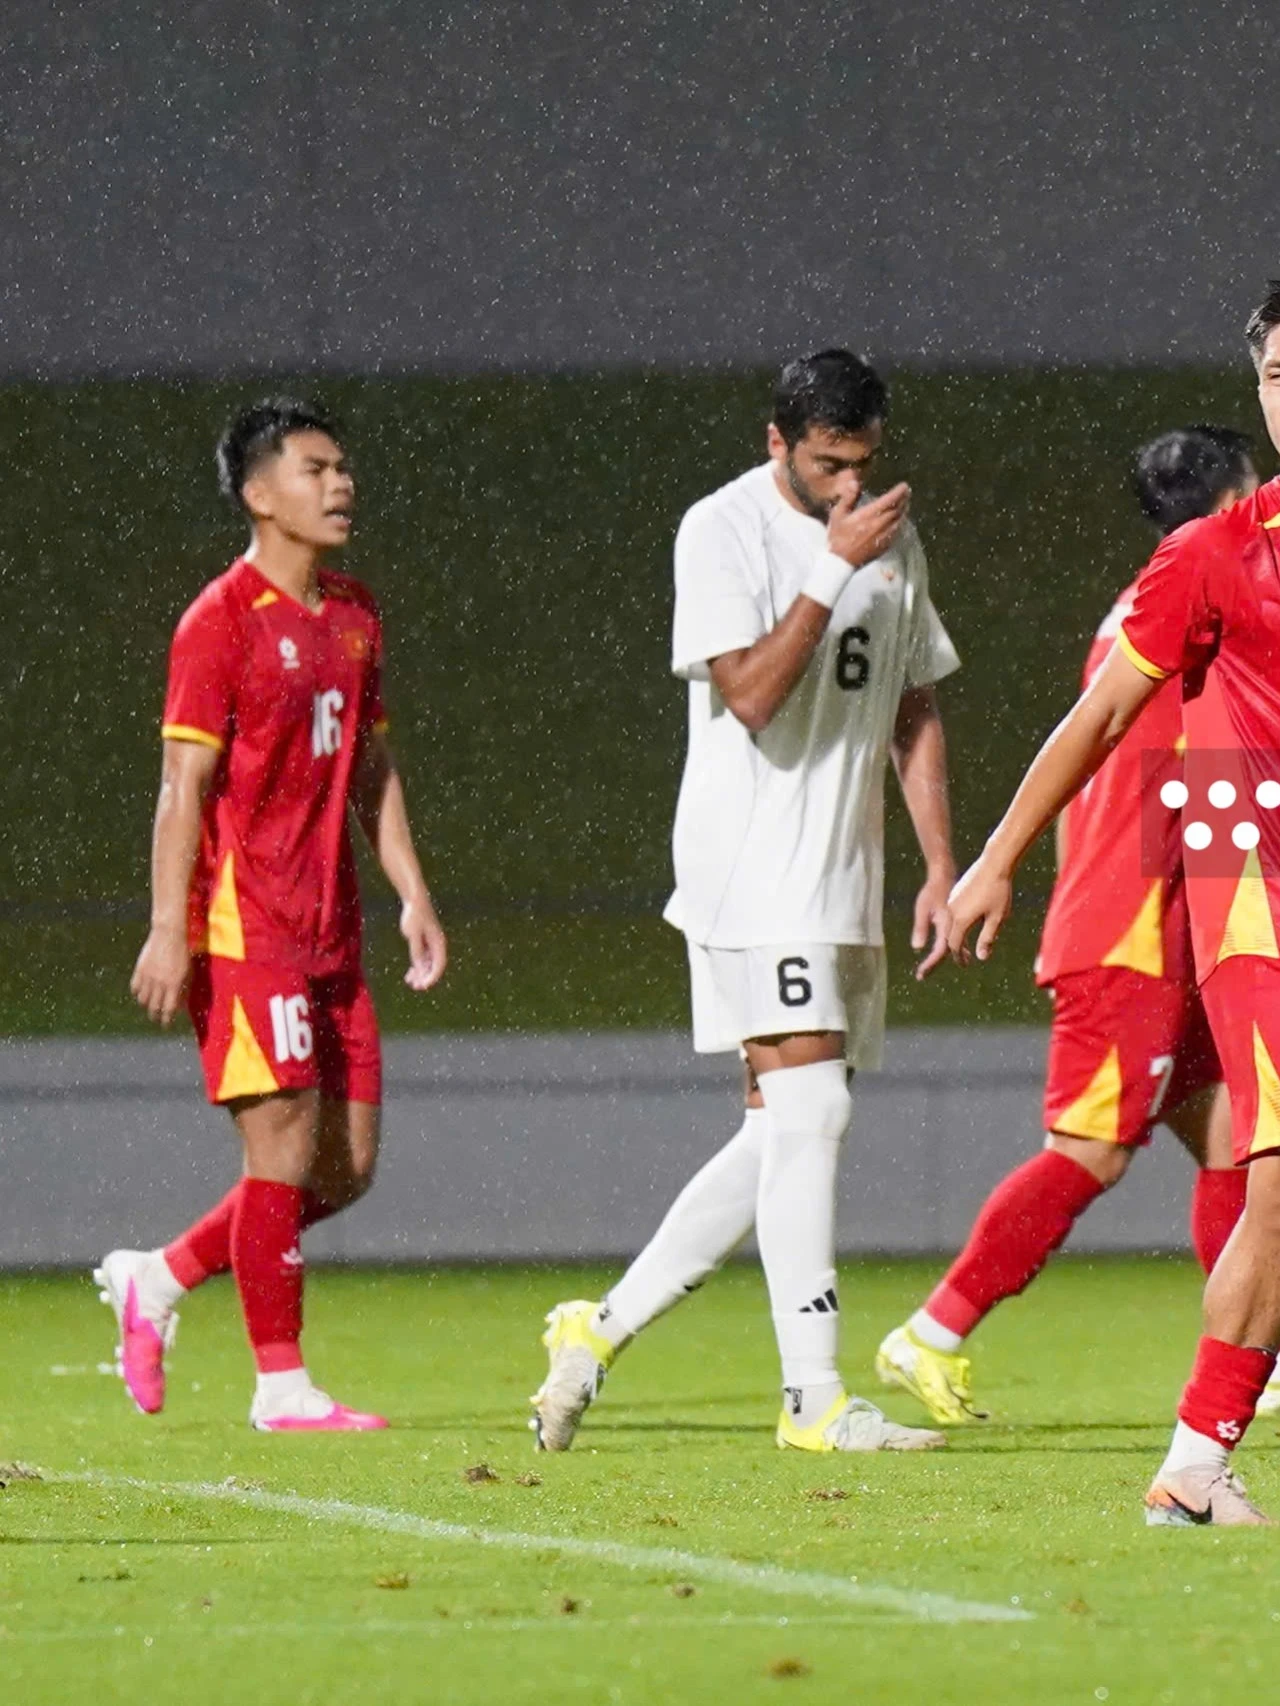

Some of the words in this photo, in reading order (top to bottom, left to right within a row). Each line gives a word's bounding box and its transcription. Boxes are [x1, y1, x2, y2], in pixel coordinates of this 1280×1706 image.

[836, 626, 870, 691] 6
[312, 688, 344, 759] 16
[777, 956, 812, 1007] 6
[269, 993, 313, 1063] 16
[1148, 1055, 1174, 1118] 7
